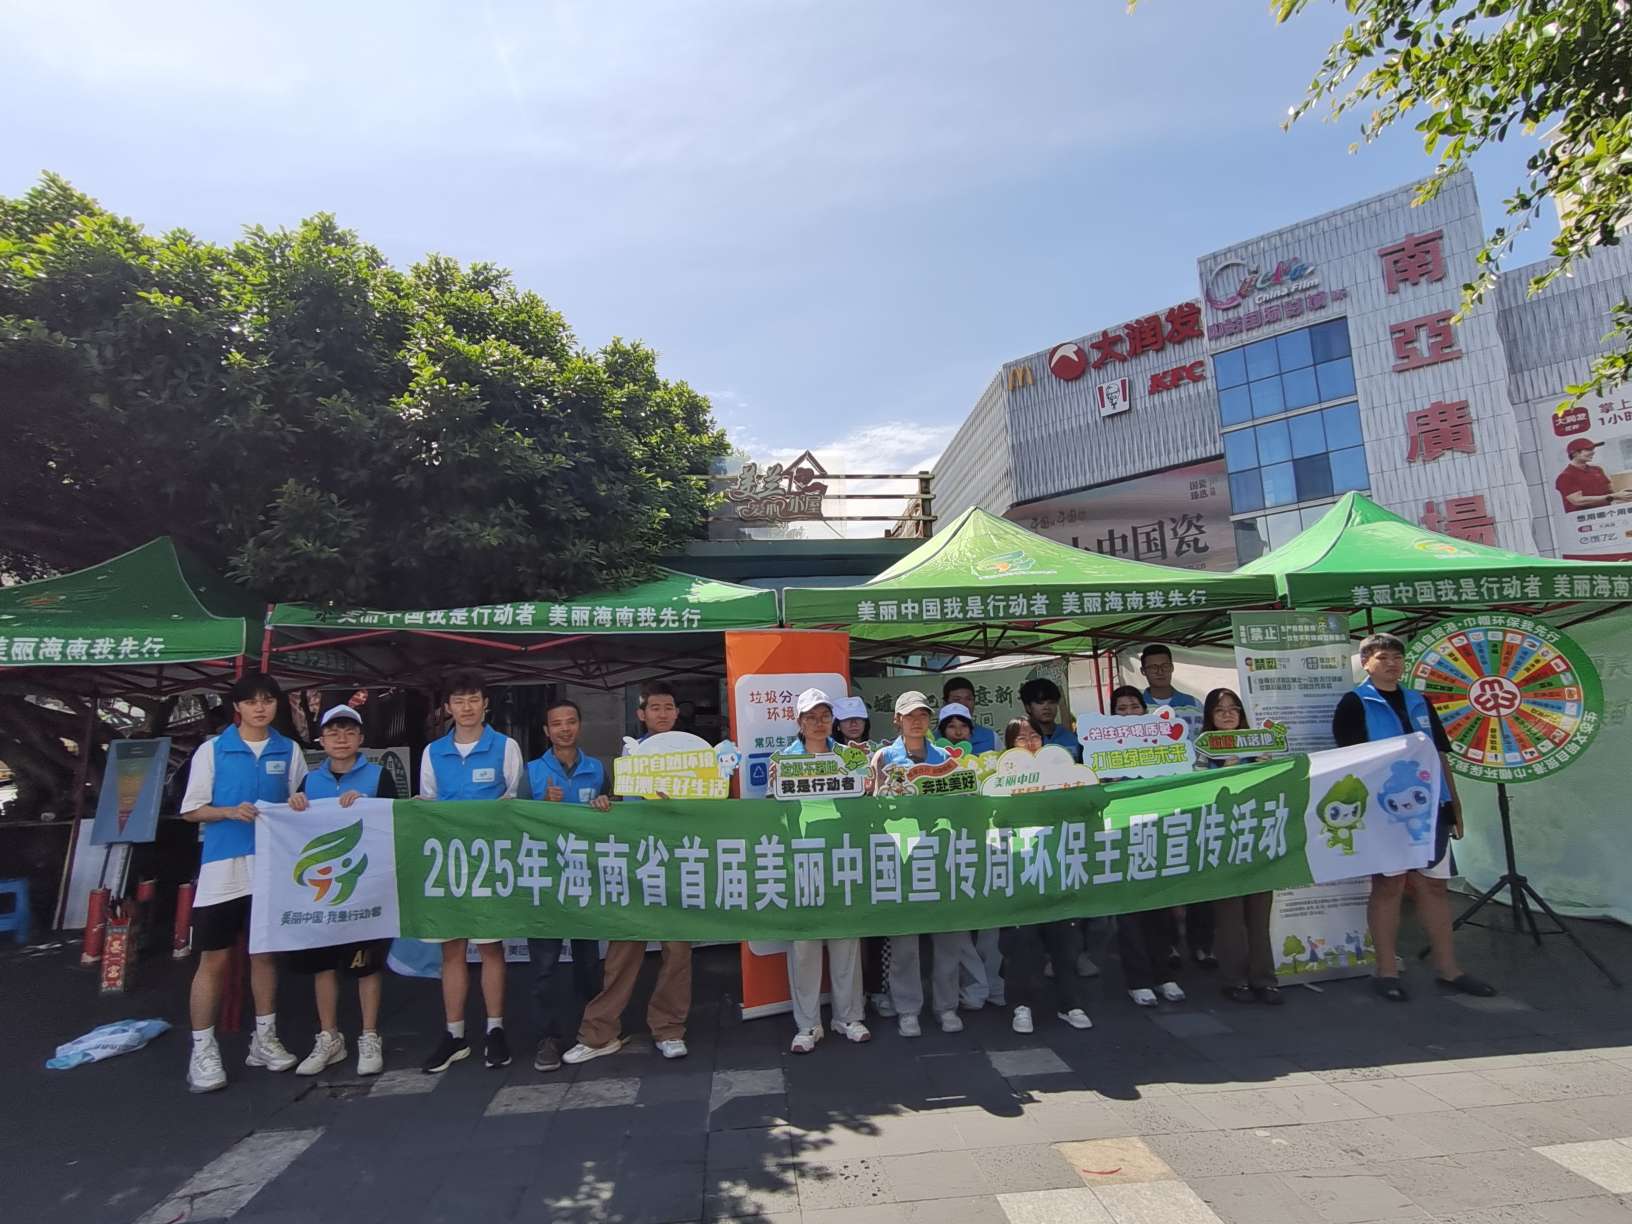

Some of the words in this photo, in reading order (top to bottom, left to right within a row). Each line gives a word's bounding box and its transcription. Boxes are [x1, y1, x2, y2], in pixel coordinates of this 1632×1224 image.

[1254, 286, 1290, 304] China
[1291, 278, 1320, 294] Film
[1090, 302, 1204, 370] 大润发
[1148, 360, 1206, 395] KFC
[1071, 513, 1210, 562] 中国瓷
[1351, 575, 1543, 606] 美丽中国我是行动者
[548, 605, 701, 628] 美丽海南我先行
[857, 592, 1049, 622] 美丽中国我是行动者
[1061, 588, 1208, 615] 美丽海南我先行
[1249, 626, 1278, 641] 禁止
[750, 690, 800, 704] 垃圾分
[1092, 745, 1188, 771] 打造绿色未来
[781, 776, 856, 794] 我是行动者
[921, 775, 976, 794] 奔赴美好
[994, 771, 1041, 788] 美丽中国
